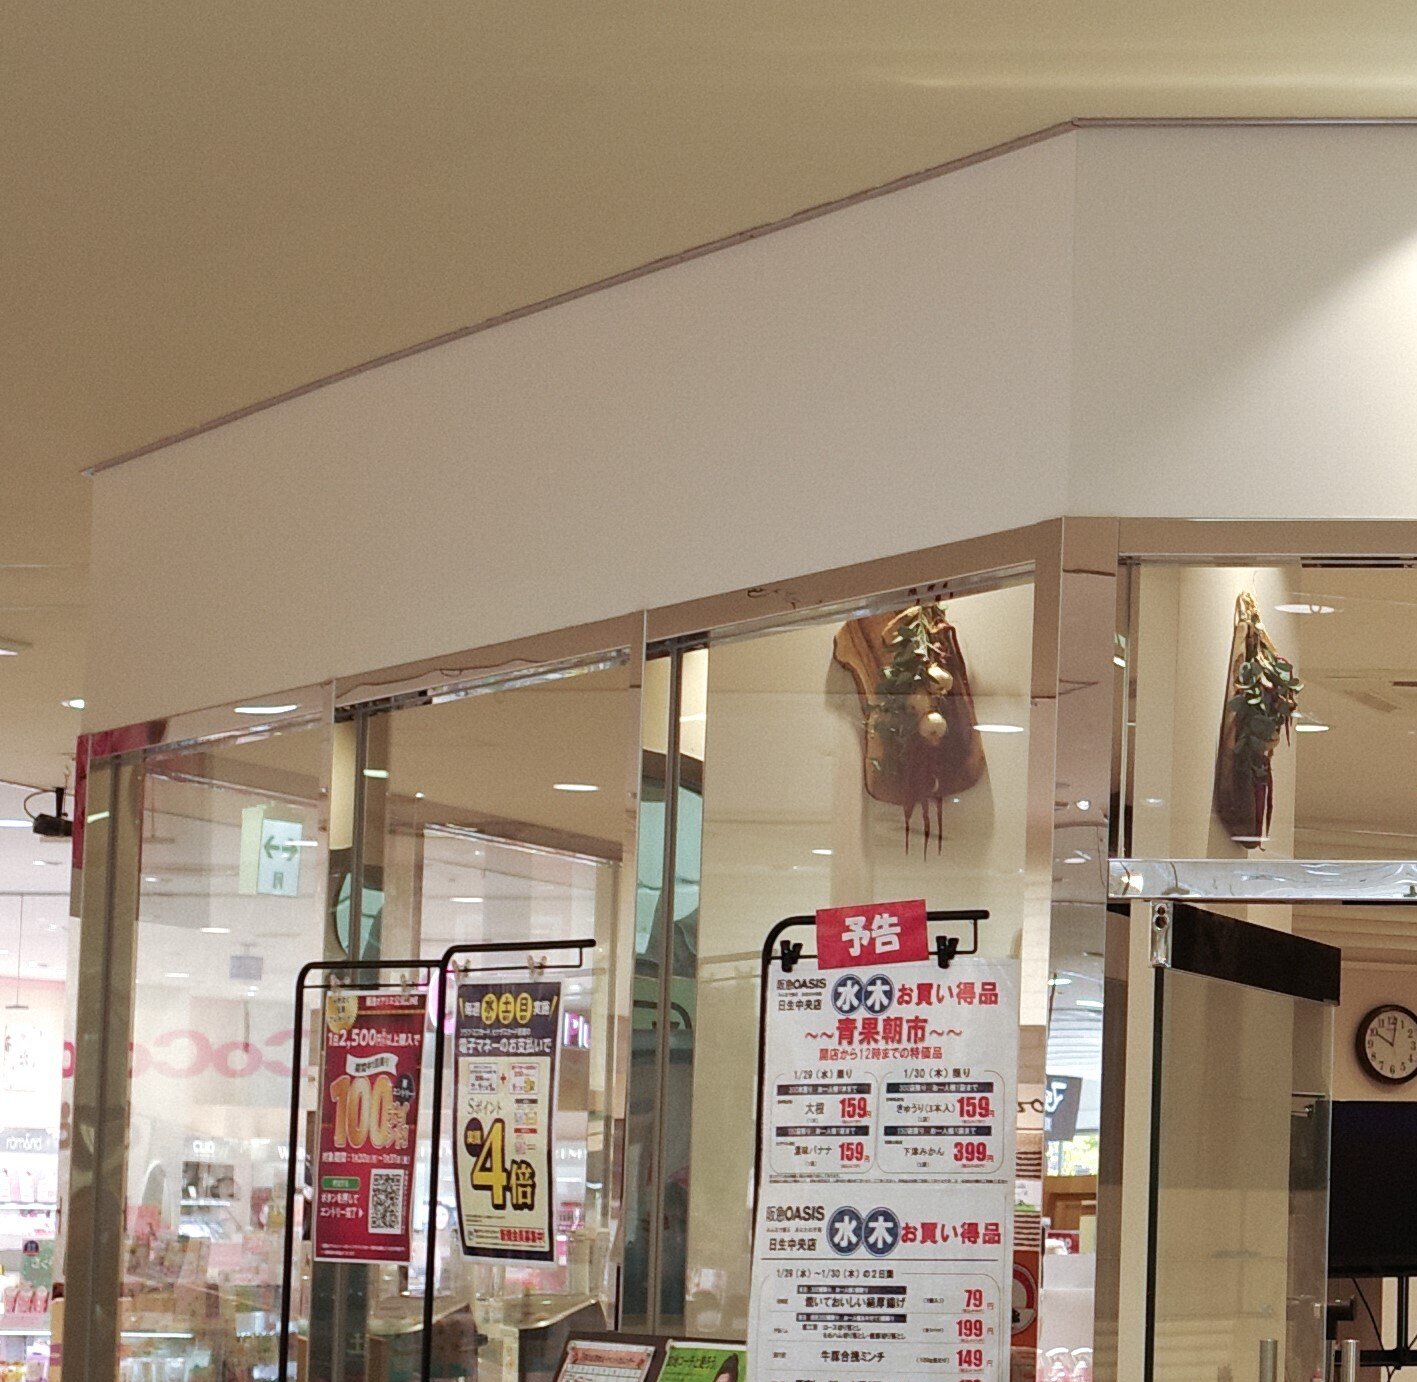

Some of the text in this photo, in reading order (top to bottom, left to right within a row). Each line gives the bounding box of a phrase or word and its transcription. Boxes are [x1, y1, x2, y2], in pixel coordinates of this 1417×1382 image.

[841, 913, 901, 957] 予告
[896, 981, 999, 1006] お買い得品
[766, 1205, 825, 1222] 阪急OASIS
[901, 1222, 1001, 1245] お買い得品
[768, 1238, 817, 1252] 日生中央店
[956, 1319, 983, 1338] 199
[956, 1349, 983, 1368] 149
